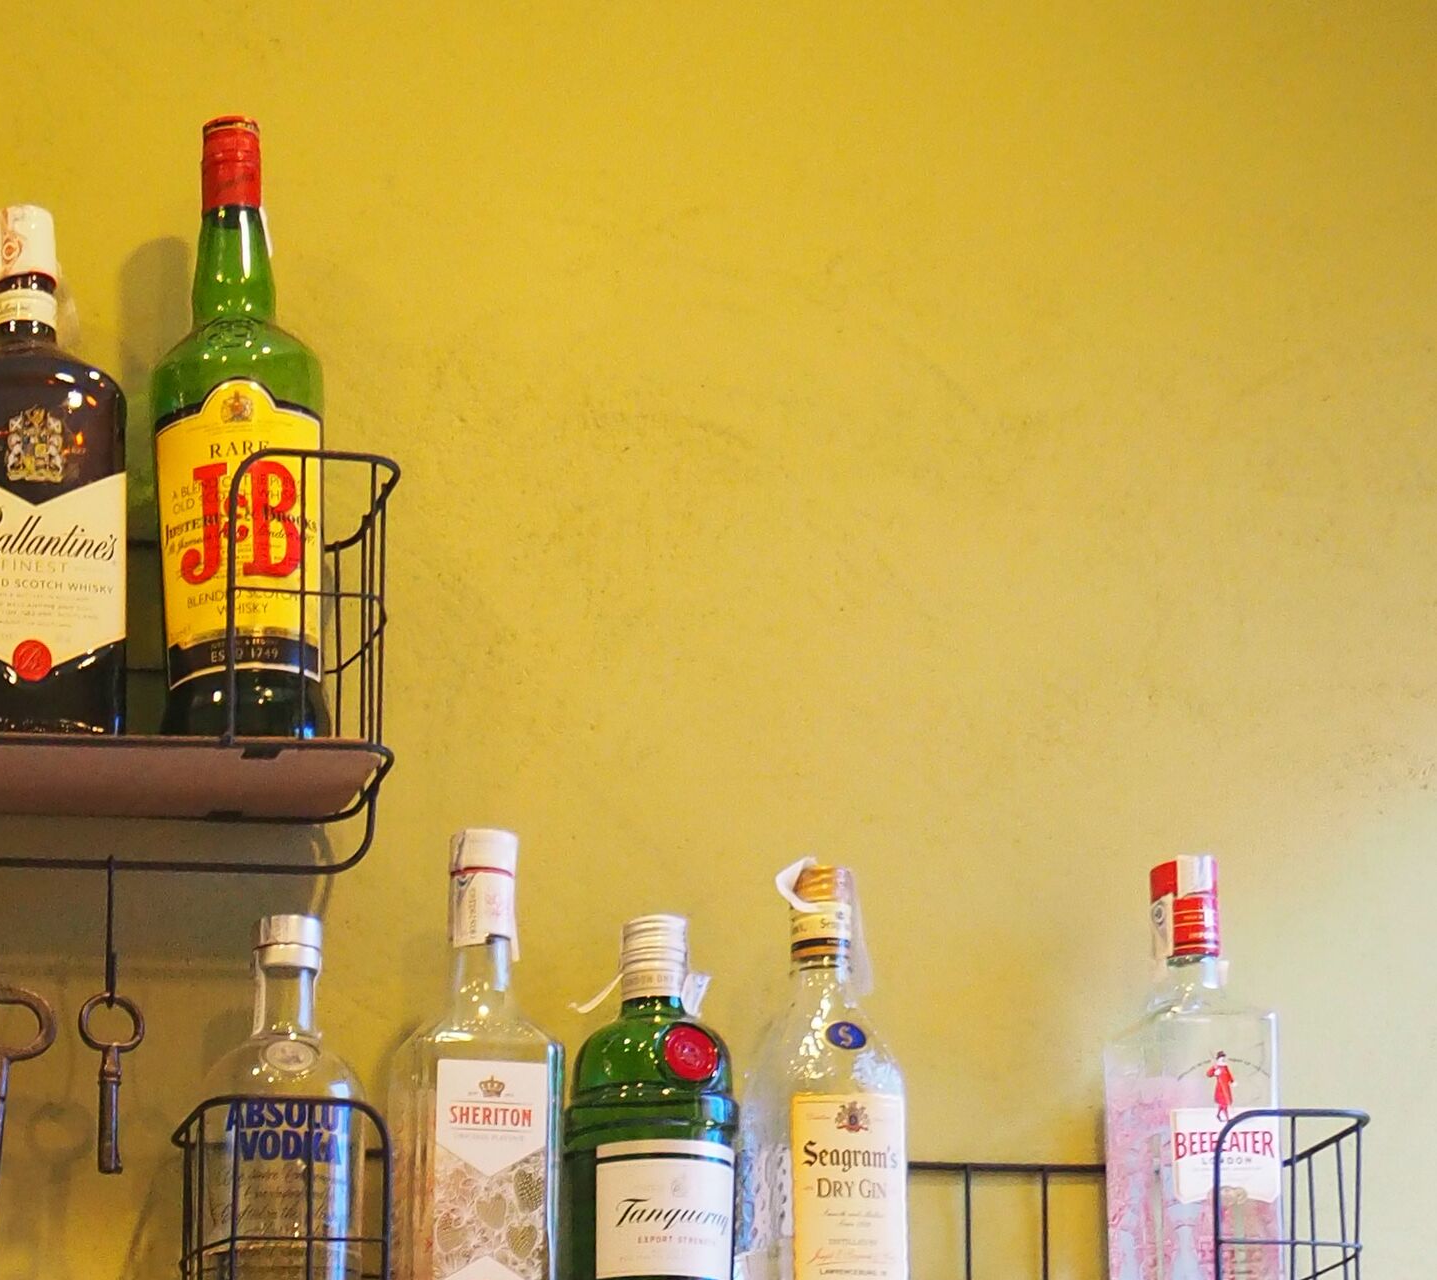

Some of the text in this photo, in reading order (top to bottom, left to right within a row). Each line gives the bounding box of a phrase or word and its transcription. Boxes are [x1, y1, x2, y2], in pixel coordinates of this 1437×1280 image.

[210, 440, 270, 459] RARE
[180, 460, 302, 585] J&B
[0, 559, 69, 573] FINEST
[14, 579, 64, 591] SCOTCH
[67, 582, 115, 595] WHISKY
[186, 589, 243, 609] BLENDD
[210, 648, 244, 663] ESD
[838, 1026, 854, 1047] S
[225, 1101, 346, 1131] ABSOLU
[449, 1105, 532, 1128] SHERITON
[239, 1129, 342, 1165] VODKA
[802, 1140, 899, 1173] Seagram's
[815, 1177, 887, 1199] DRY GIN
[615, 1198, 730, 1236] Tanqueray
[677, 1236, 716, 1246] STRENG
